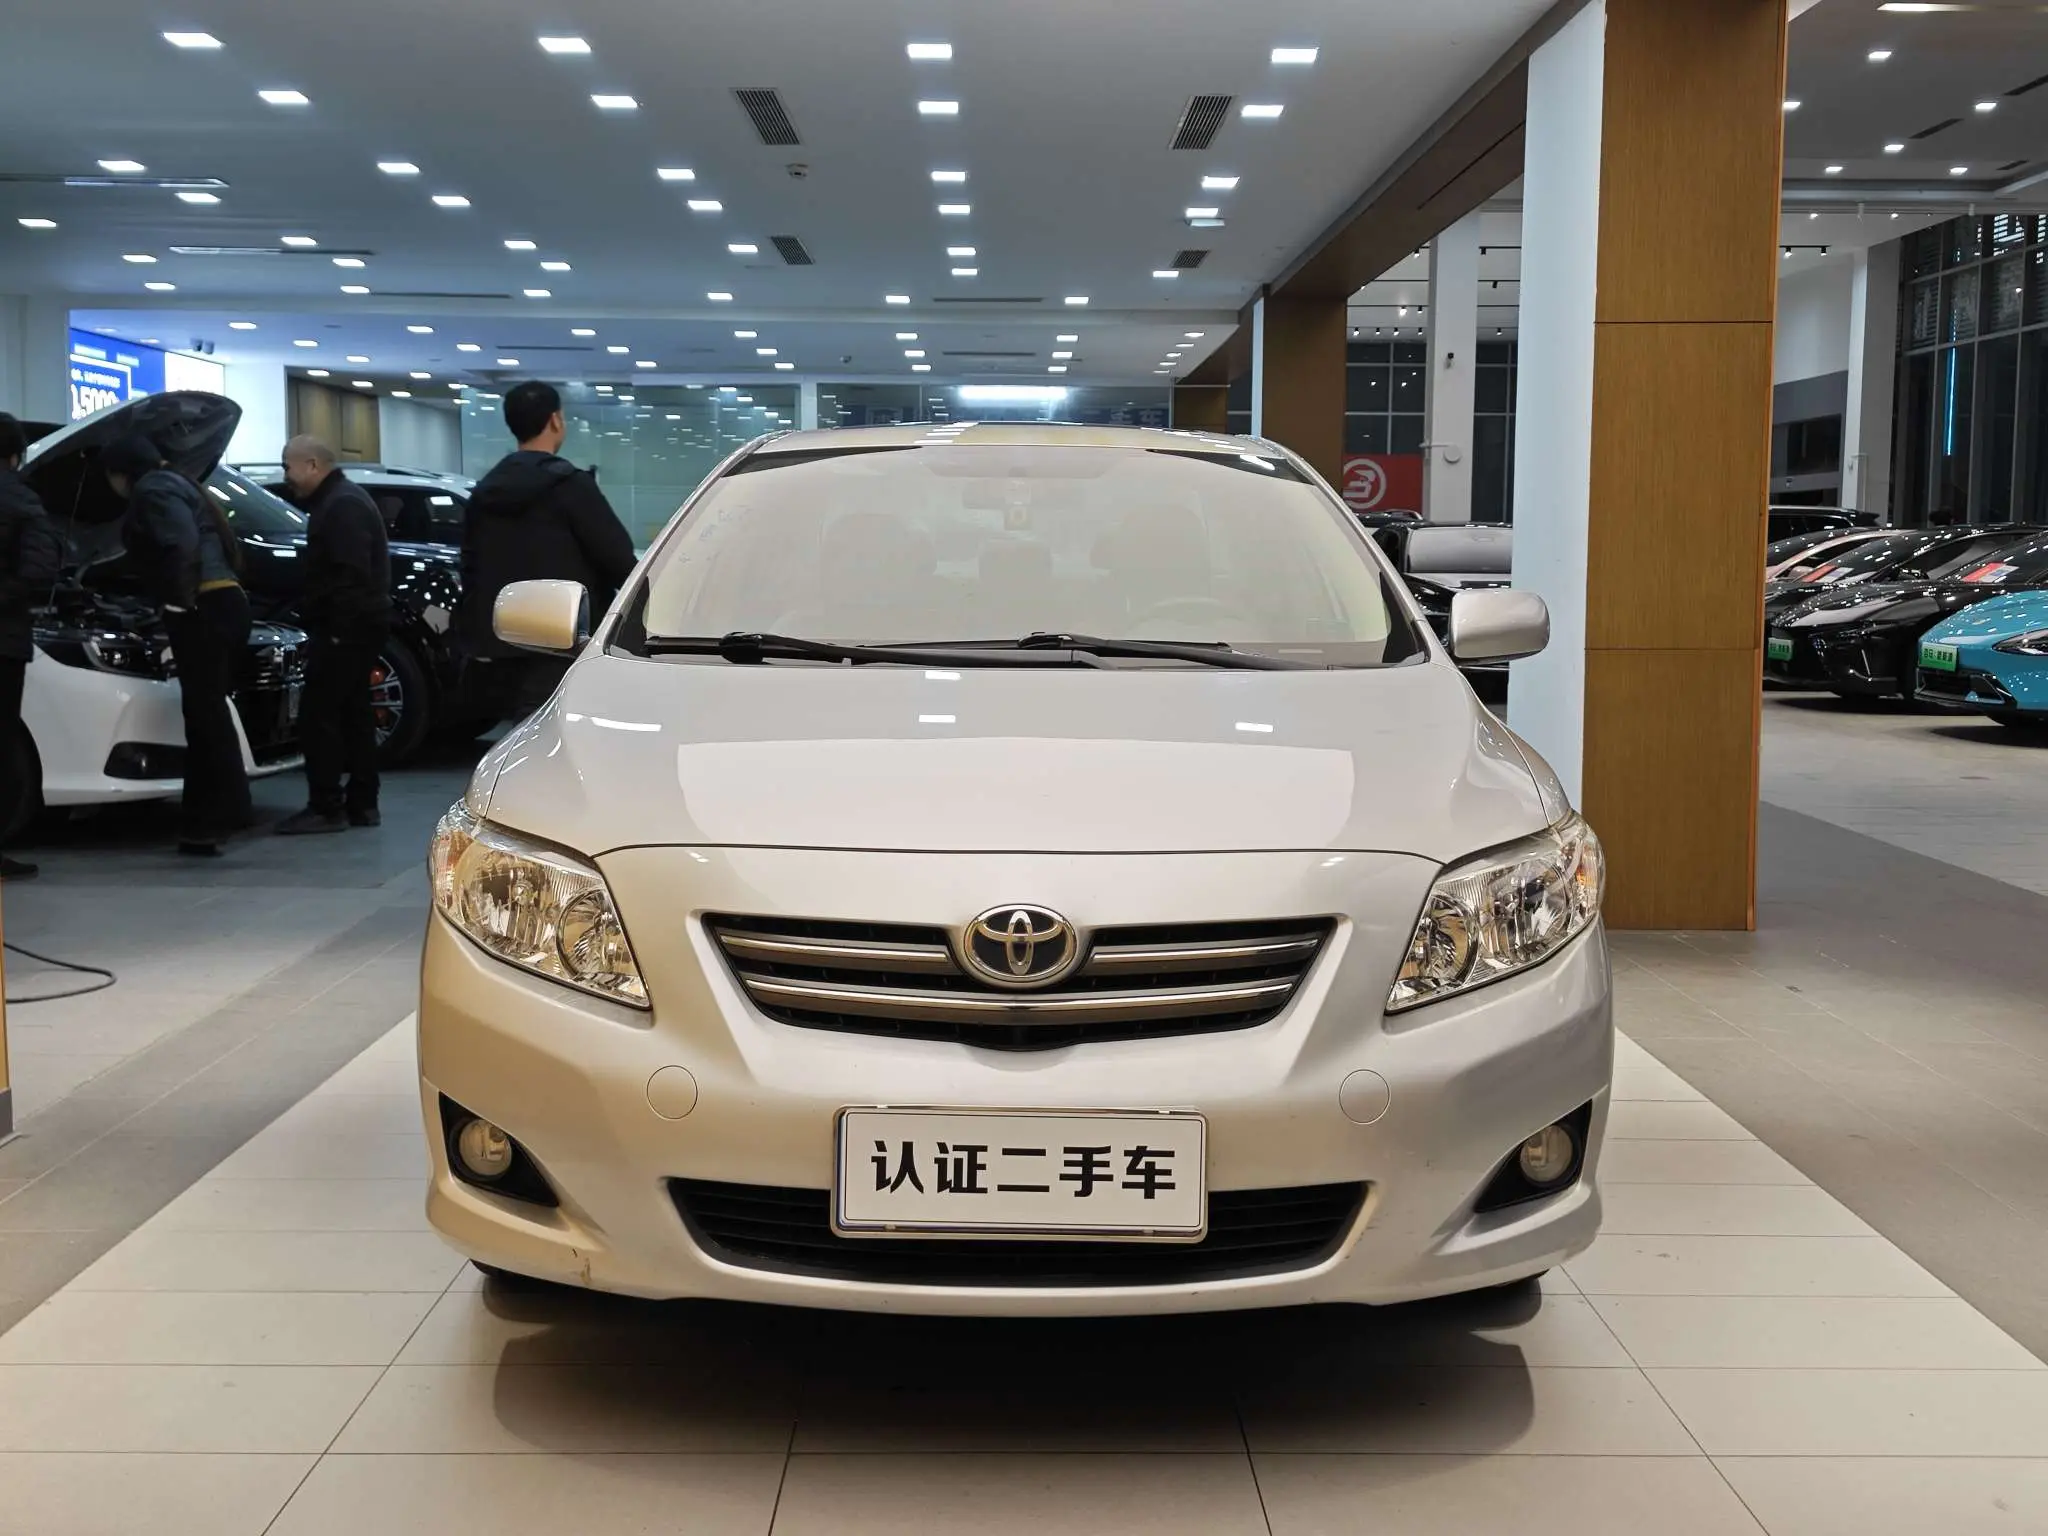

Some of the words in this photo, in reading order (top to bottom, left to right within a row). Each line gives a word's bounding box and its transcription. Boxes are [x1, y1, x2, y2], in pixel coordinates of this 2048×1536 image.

[871, 1140, 1176, 1199] 认证二手车
